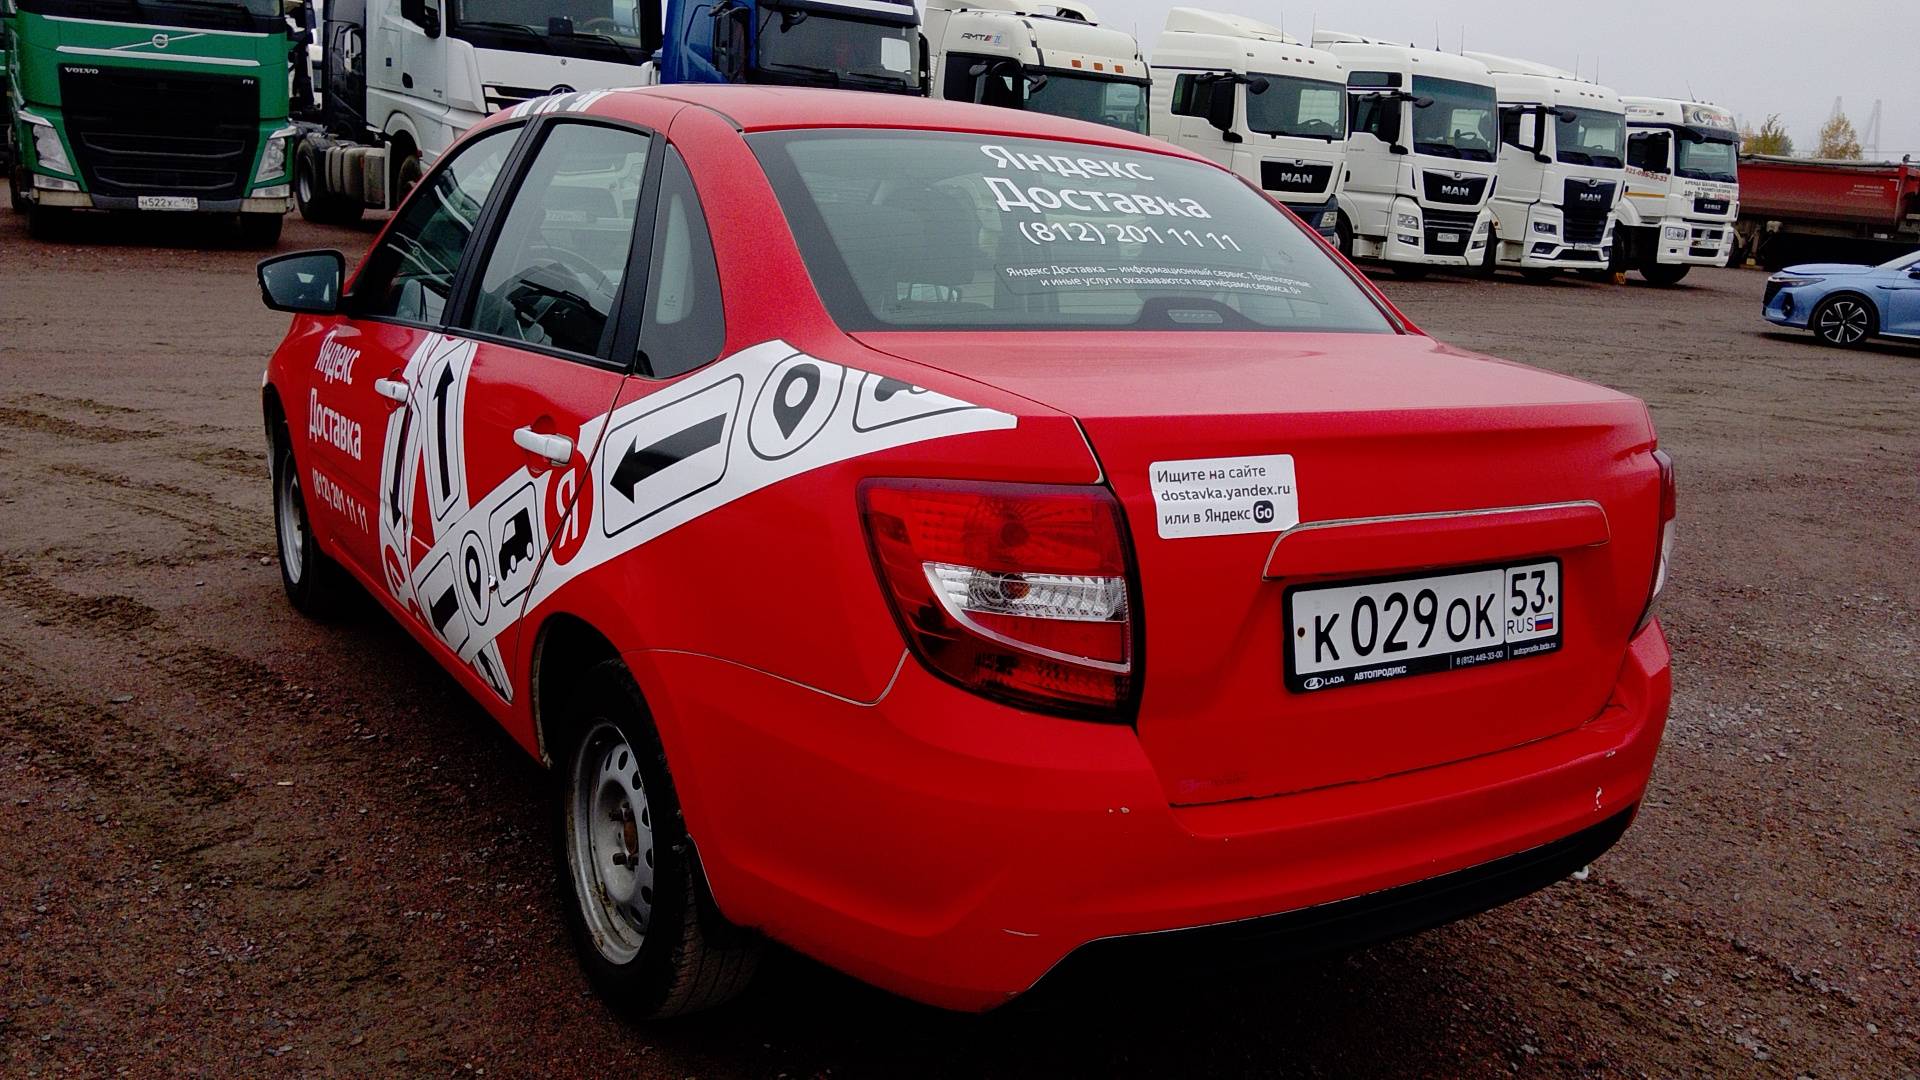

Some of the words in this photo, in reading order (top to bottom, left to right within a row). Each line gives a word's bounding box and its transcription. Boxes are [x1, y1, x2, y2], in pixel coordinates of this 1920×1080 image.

[64, 66, 99, 74] VOLVO
[980, 145, 1155, 181] Яндекс
[1280, 172, 1313, 184] MAN
[983, 176, 1213, 219] Доставка
[1441, 185, 1469, 196] MAN
[1579, 193, 1601, 202] MAN
[1018, 221, 1107, 245] (812)
[1107, 224, 1165, 244] 201
[1167, 227, 1204, 248] 11
[1206, 231, 1243, 252] 11
[1006, 266, 1051, 277] Яндекс
[1051, 265, 1106, 276] Доставка
[1119, 264, 1213, 276] информационный
[1040, 279, 1050, 287] и
[1051, 278, 1082, 286] иные
[1082, 277, 1122, 287] услуги
[1122, 277, 1193, 286] оказываются
[315, 329, 361, 385] Яндекс
[309, 387, 362, 461] Доставка
[1157, 470, 1206, 484] Ищите
[1209, 468, 1225, 480] на
[1228, 465, 1266, 478] сайте
[311, 466, 333, 510] (812)
[330, 481, 347, 516] 201
[346, 494, 358, 525] 11
[357, 503, 369, 535] 11
[1161, 483, 1291, 501] dostavka.yandex.ru
[556, 467, 579, 549] Я
[1165, 513, 1190, 525] или
[1193, 512, 1201, 523] в
[1205, 508, 1250, 523] Яндекс
[1255, 504, 1273, 520] Go
[1314, 588, 1496, 663] К029ОК
[1507, 616, 1535, 635] RUS
[1461, 655, 1475, 666] (812)
[1475, 650, 1504, 662] 449-33-00
[1324, 675, 1345, 685] LADA
[1354, 665, 1407, 680] АВТОПРОДИКС
